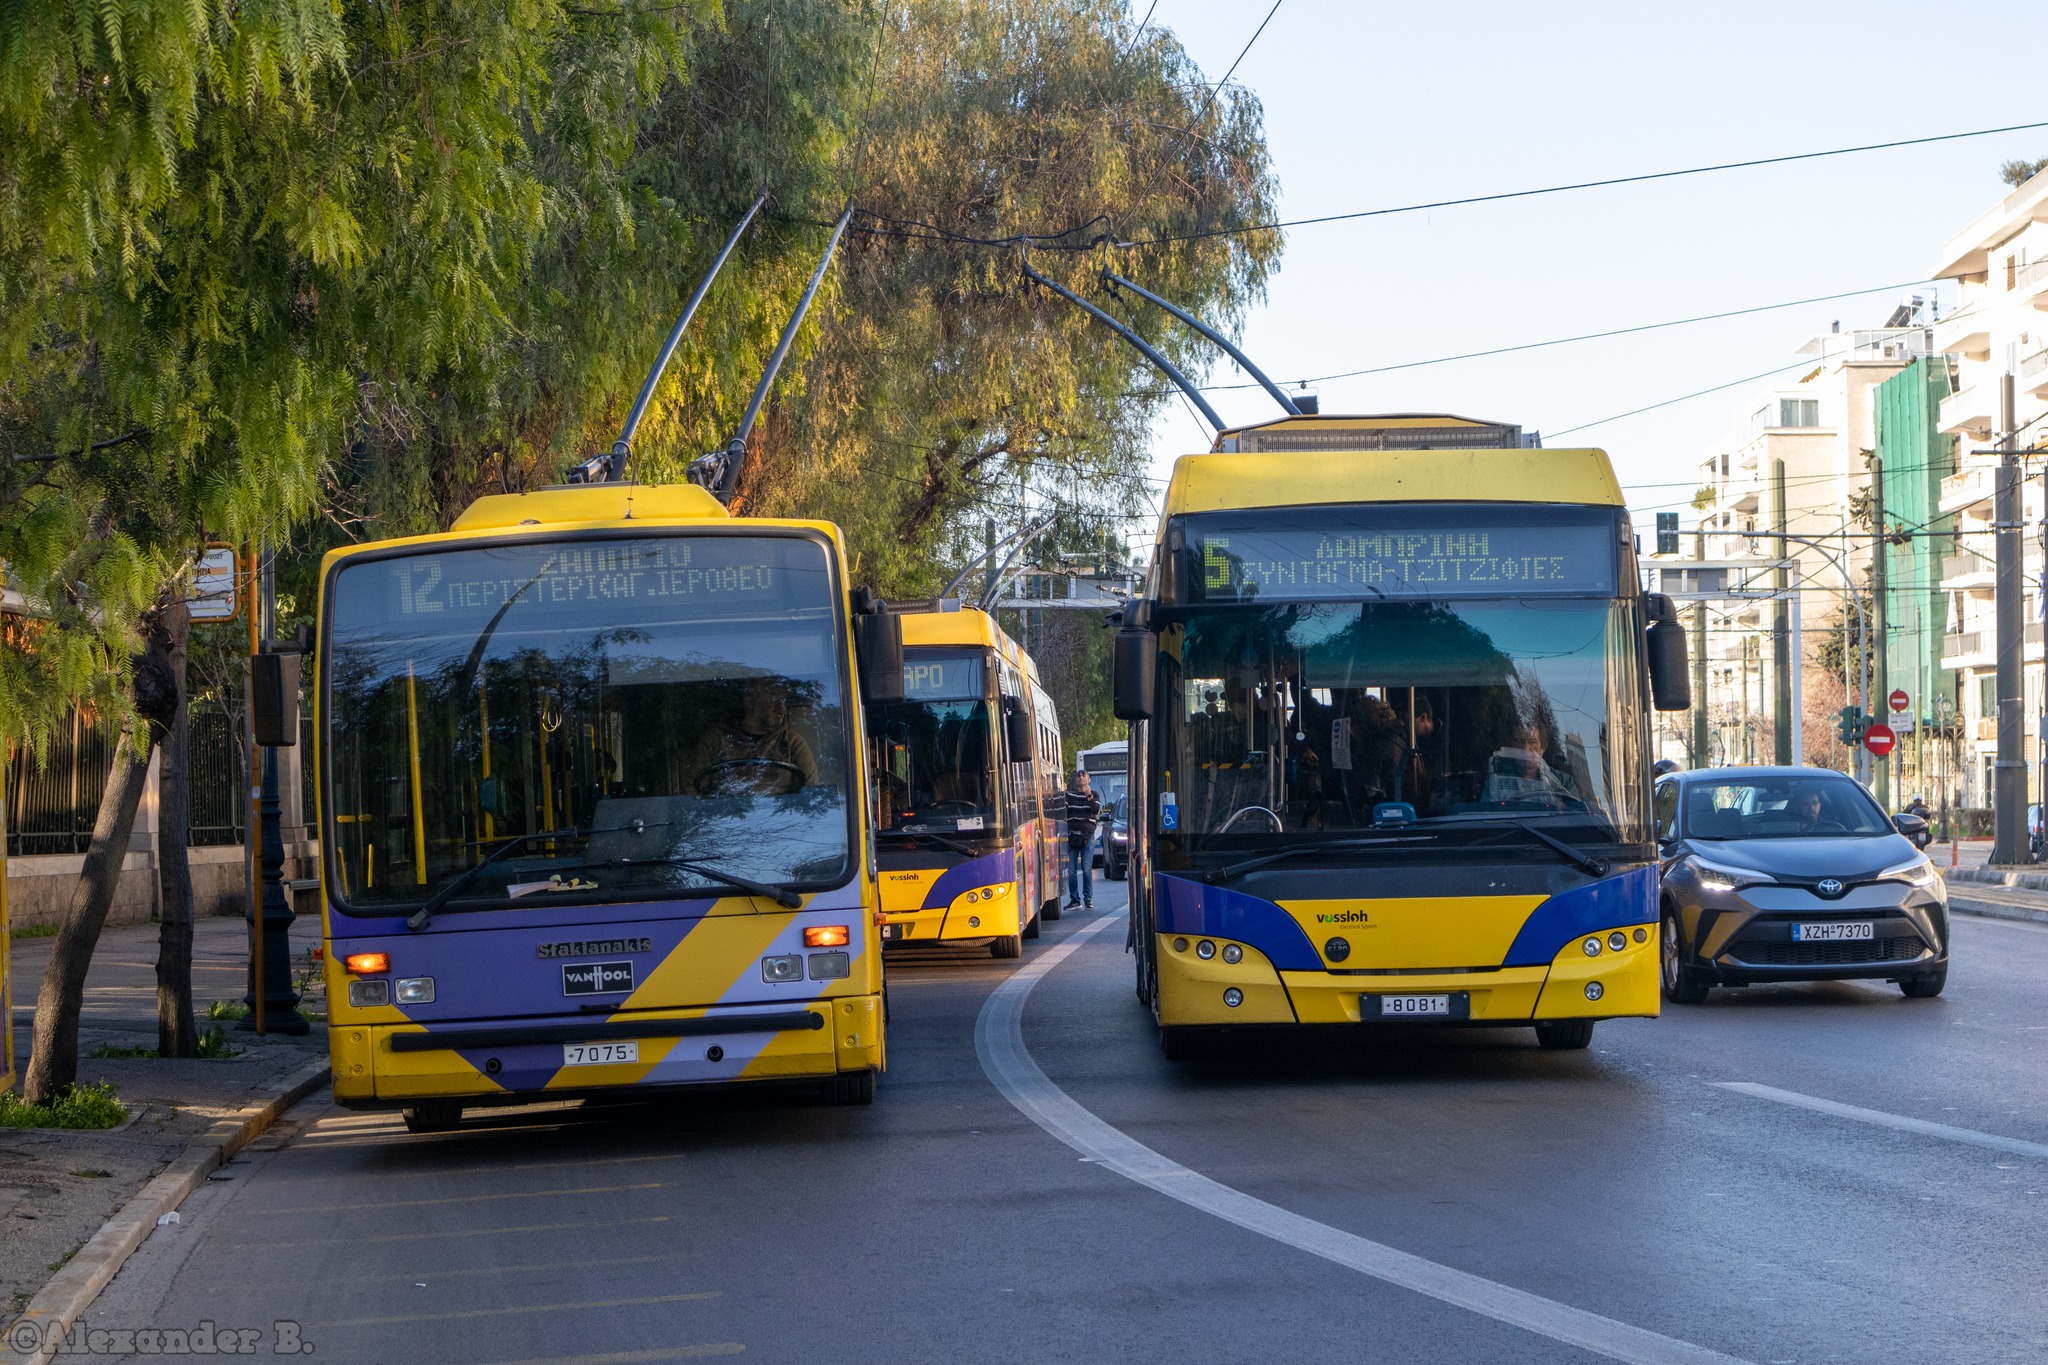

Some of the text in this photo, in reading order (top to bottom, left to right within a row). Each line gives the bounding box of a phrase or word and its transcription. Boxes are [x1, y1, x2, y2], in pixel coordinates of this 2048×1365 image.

[1203, 538, 1231, 589] 5
[392, 559, 445, 614] 12
[889, 873, 919, 881] vossloh
[1316, 909, 1368, 923] vossloh
[1393, 998, 1437, 1012] 8081
[573, 1045, 628, 1063] 7075
